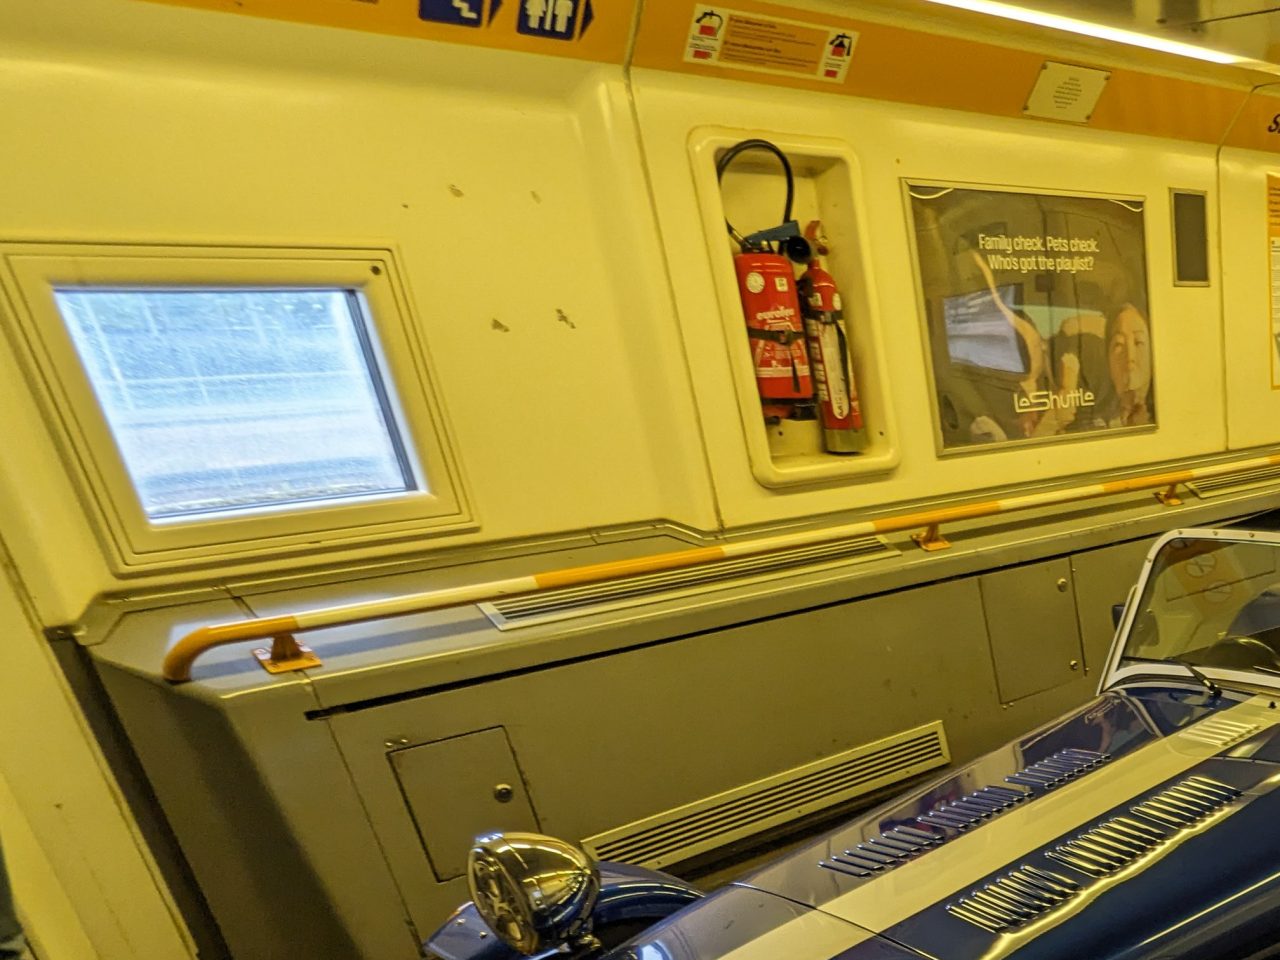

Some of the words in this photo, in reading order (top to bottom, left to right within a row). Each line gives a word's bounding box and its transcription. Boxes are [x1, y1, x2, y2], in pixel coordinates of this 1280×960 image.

[978, 233, 1013, 254] Family
[1013, 236, 1046, 251] check.
[1046, 236, 1069, 251] Pets
[1070, 238, 1100, 253] check.
[987, 254, 1019, 270] Who's
[1020, 256, 1038, 274] got
[1037, 255, 1055, 271] the
[1056, 256, 1094, 274] playlist?
[1013, 388, 1095, 413] LeShuttle
